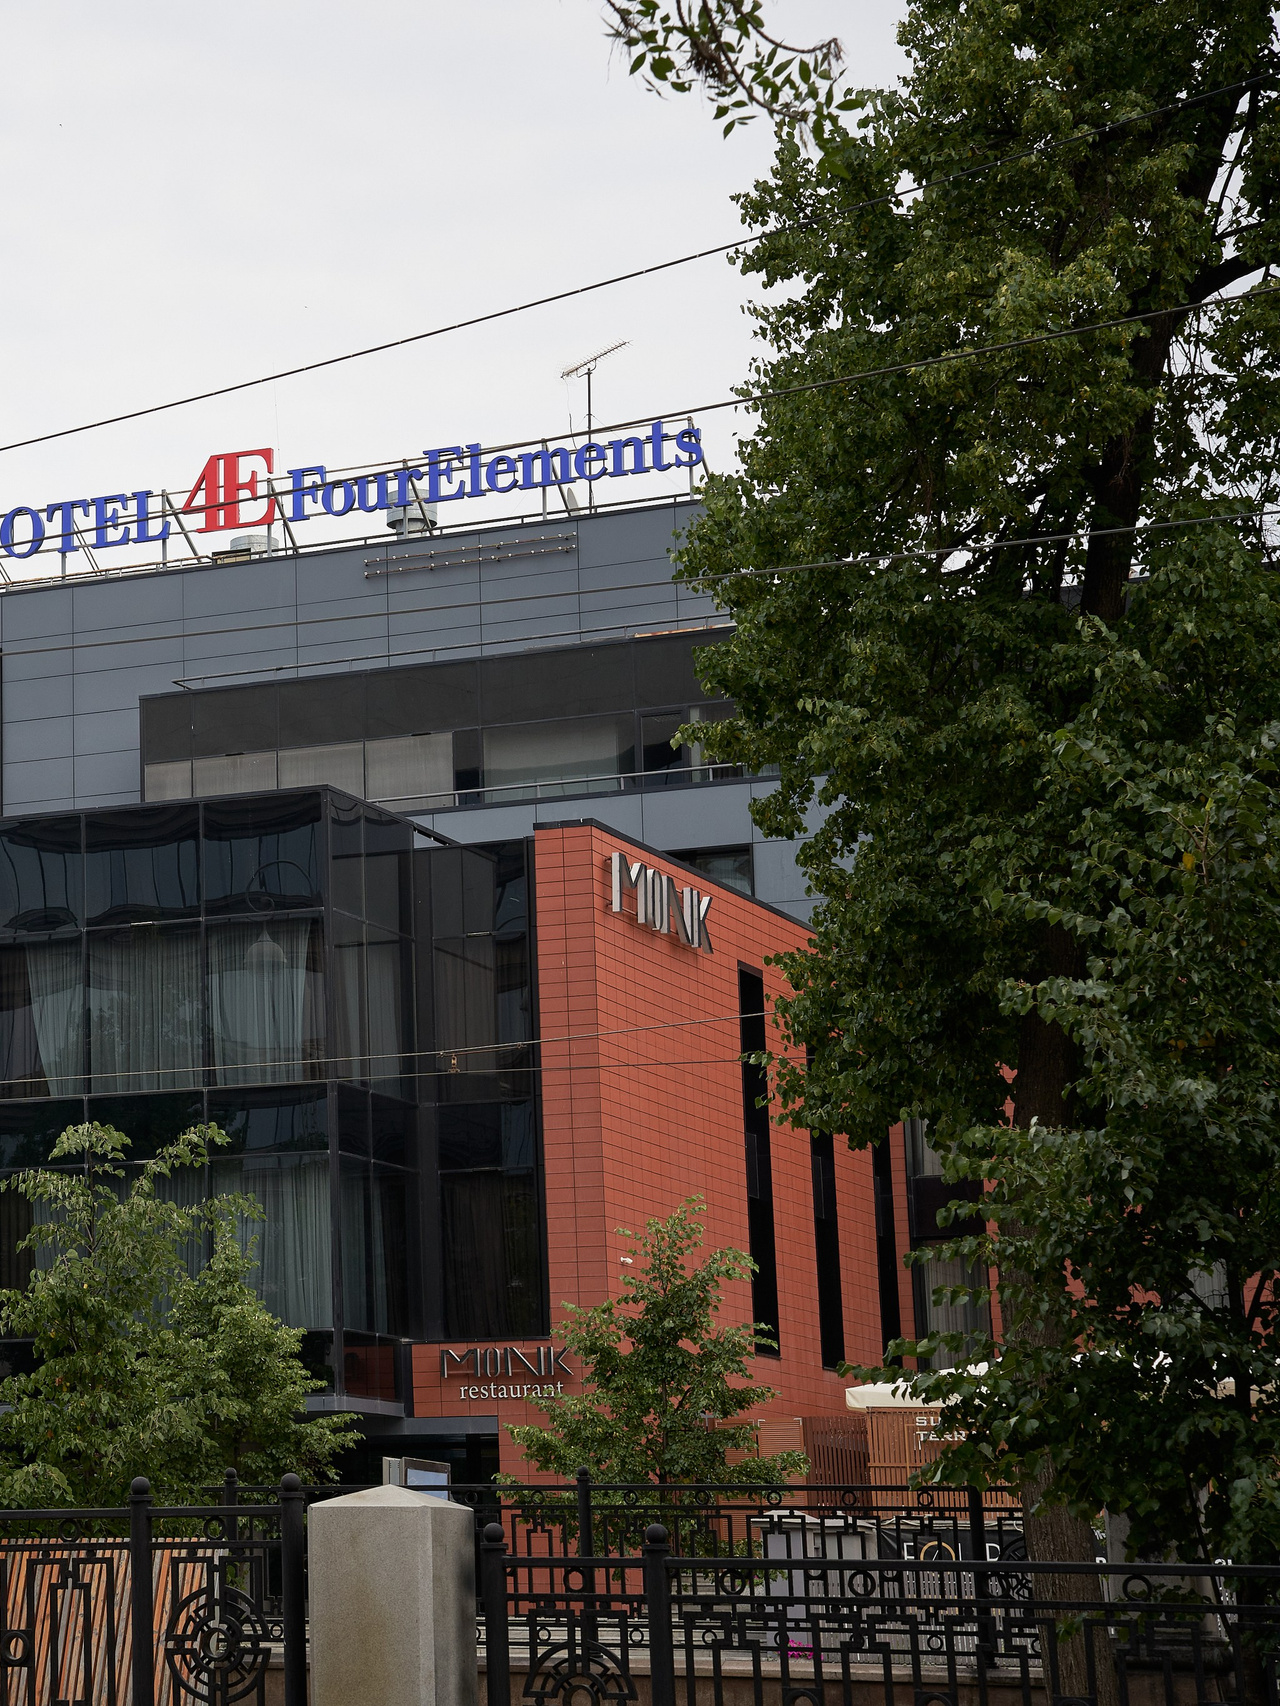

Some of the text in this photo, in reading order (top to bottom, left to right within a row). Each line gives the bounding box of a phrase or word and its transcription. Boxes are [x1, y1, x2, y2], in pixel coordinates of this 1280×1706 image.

[612, 852, 714, 954] MONK
[440, 1346, 574, 1378] MONK
[459, 1381, 563, 1400] restaurant
